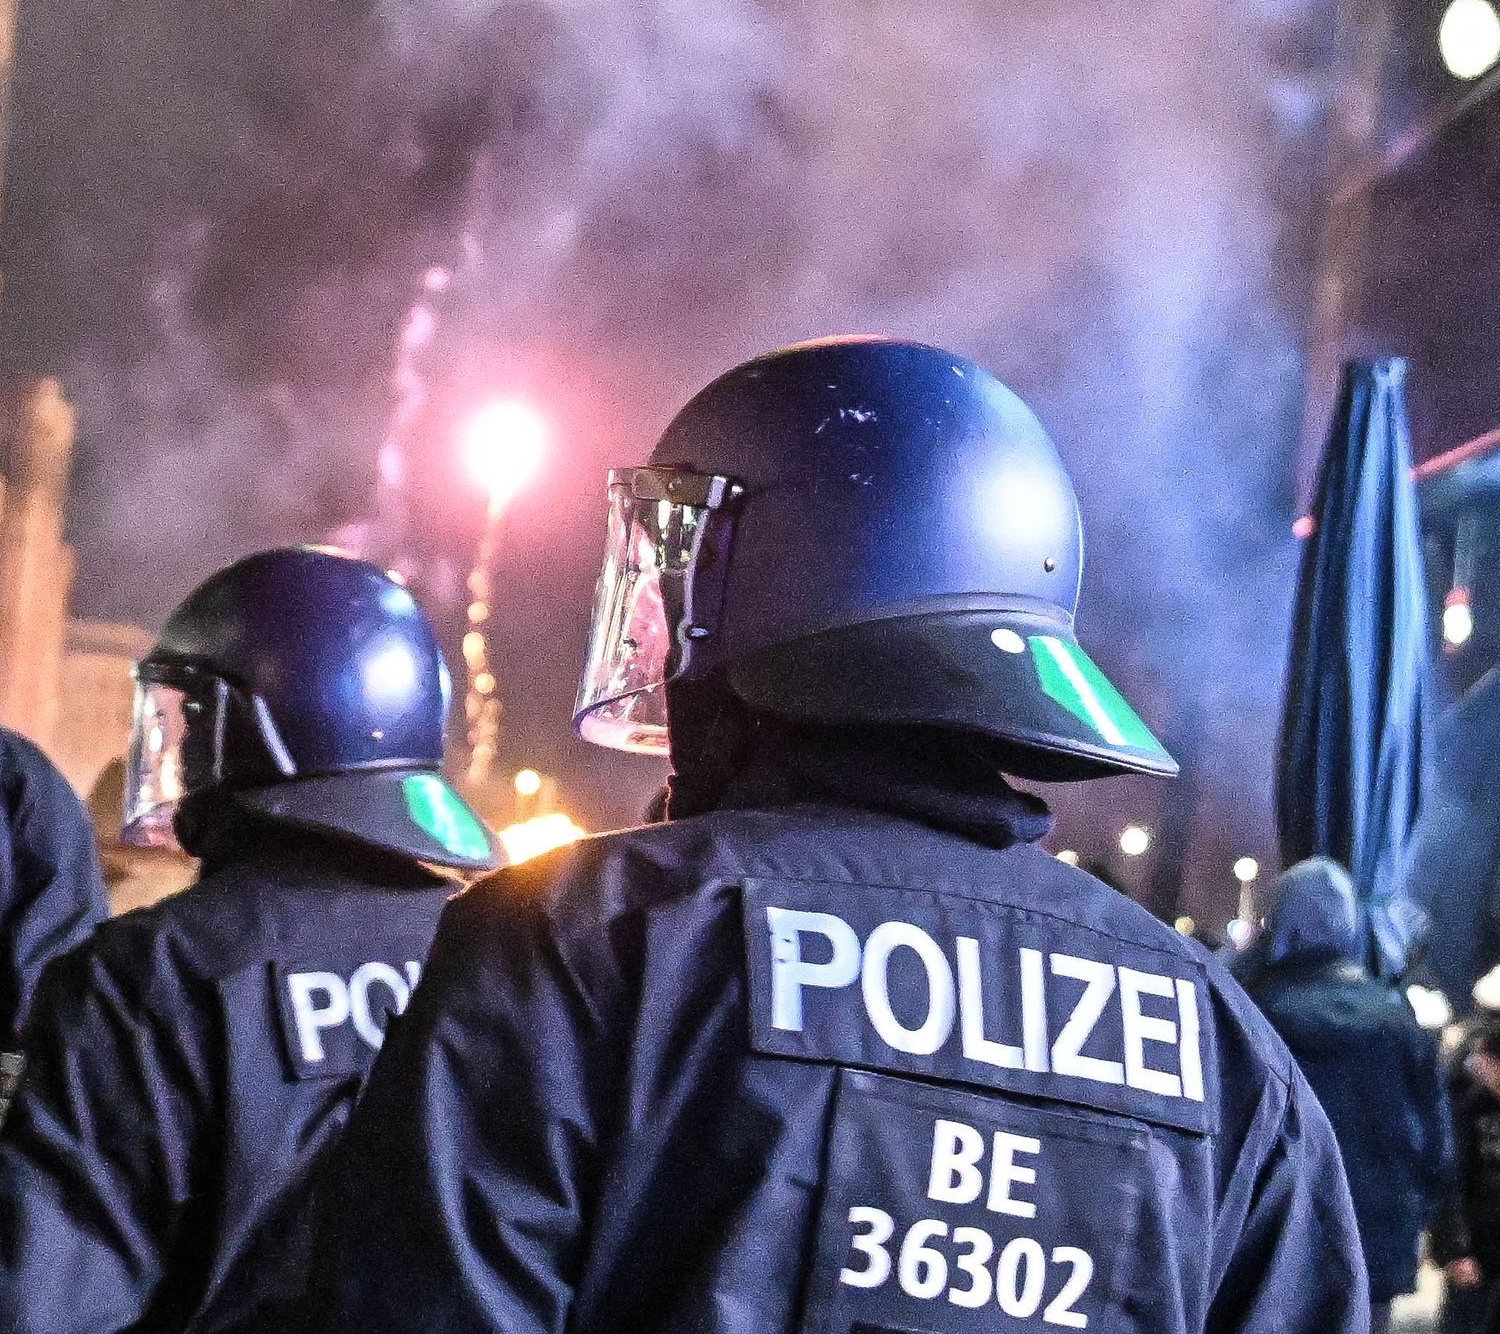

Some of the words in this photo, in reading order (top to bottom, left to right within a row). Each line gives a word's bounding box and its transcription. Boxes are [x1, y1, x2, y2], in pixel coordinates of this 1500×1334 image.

[286, 960, 422, 1063] PO
[765, 905, 1206, 1103] POLIZEI
[925, 1118, 1042, 1219] BE
[838, 1205, 1096, 1330] 36302
